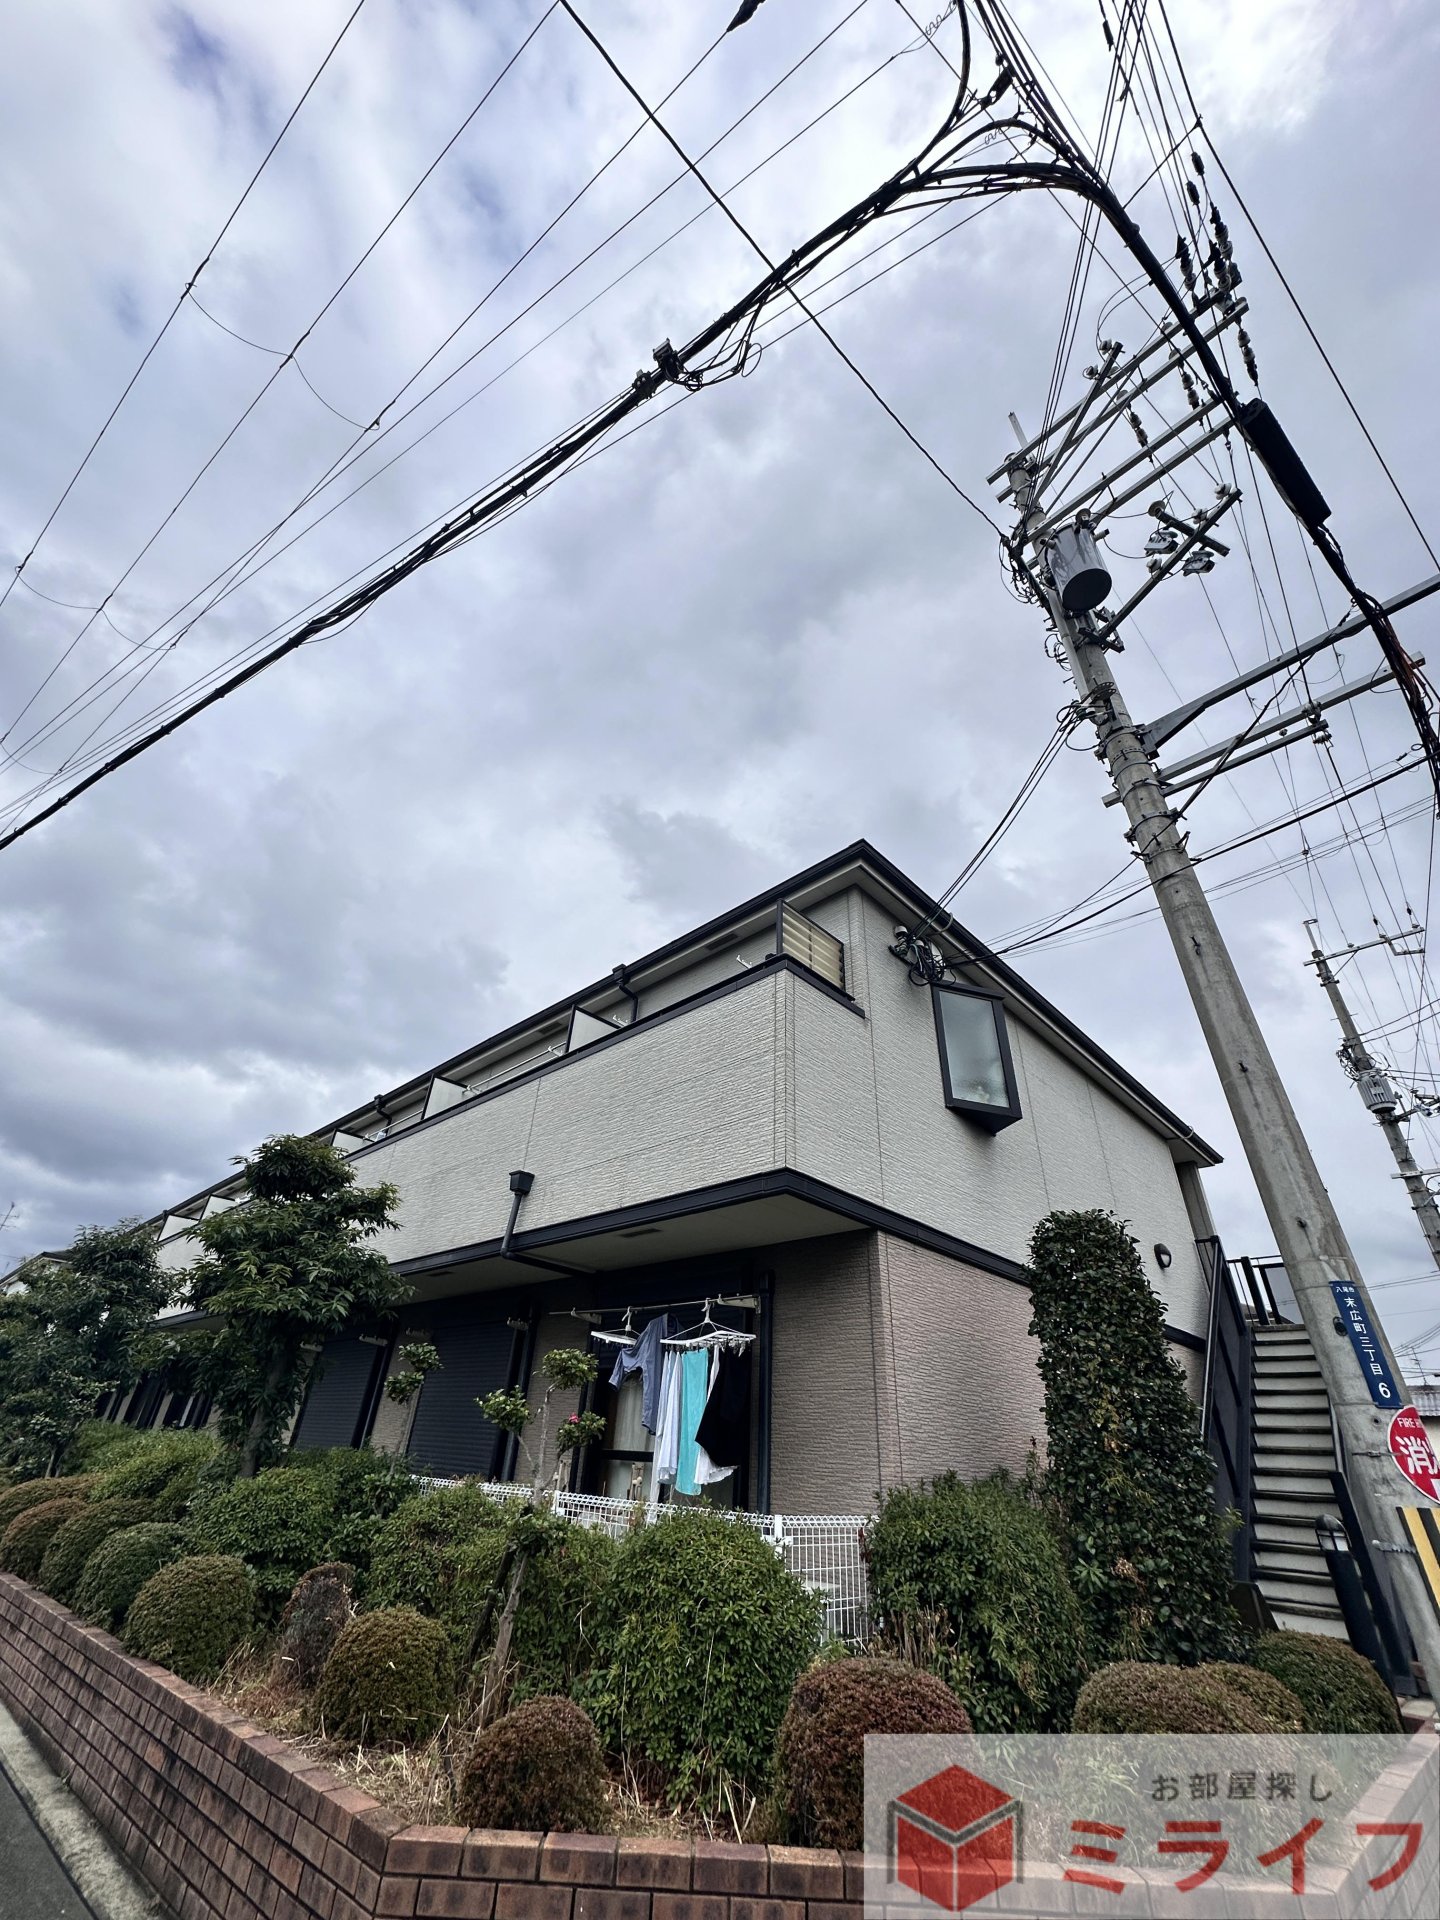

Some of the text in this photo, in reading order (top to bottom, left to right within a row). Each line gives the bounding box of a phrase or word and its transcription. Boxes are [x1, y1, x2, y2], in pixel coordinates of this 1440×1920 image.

[1344, 1296, 1391, 1399] 末広町三丁目 6
[1397, 1417, 1416, 1428] FIRE
